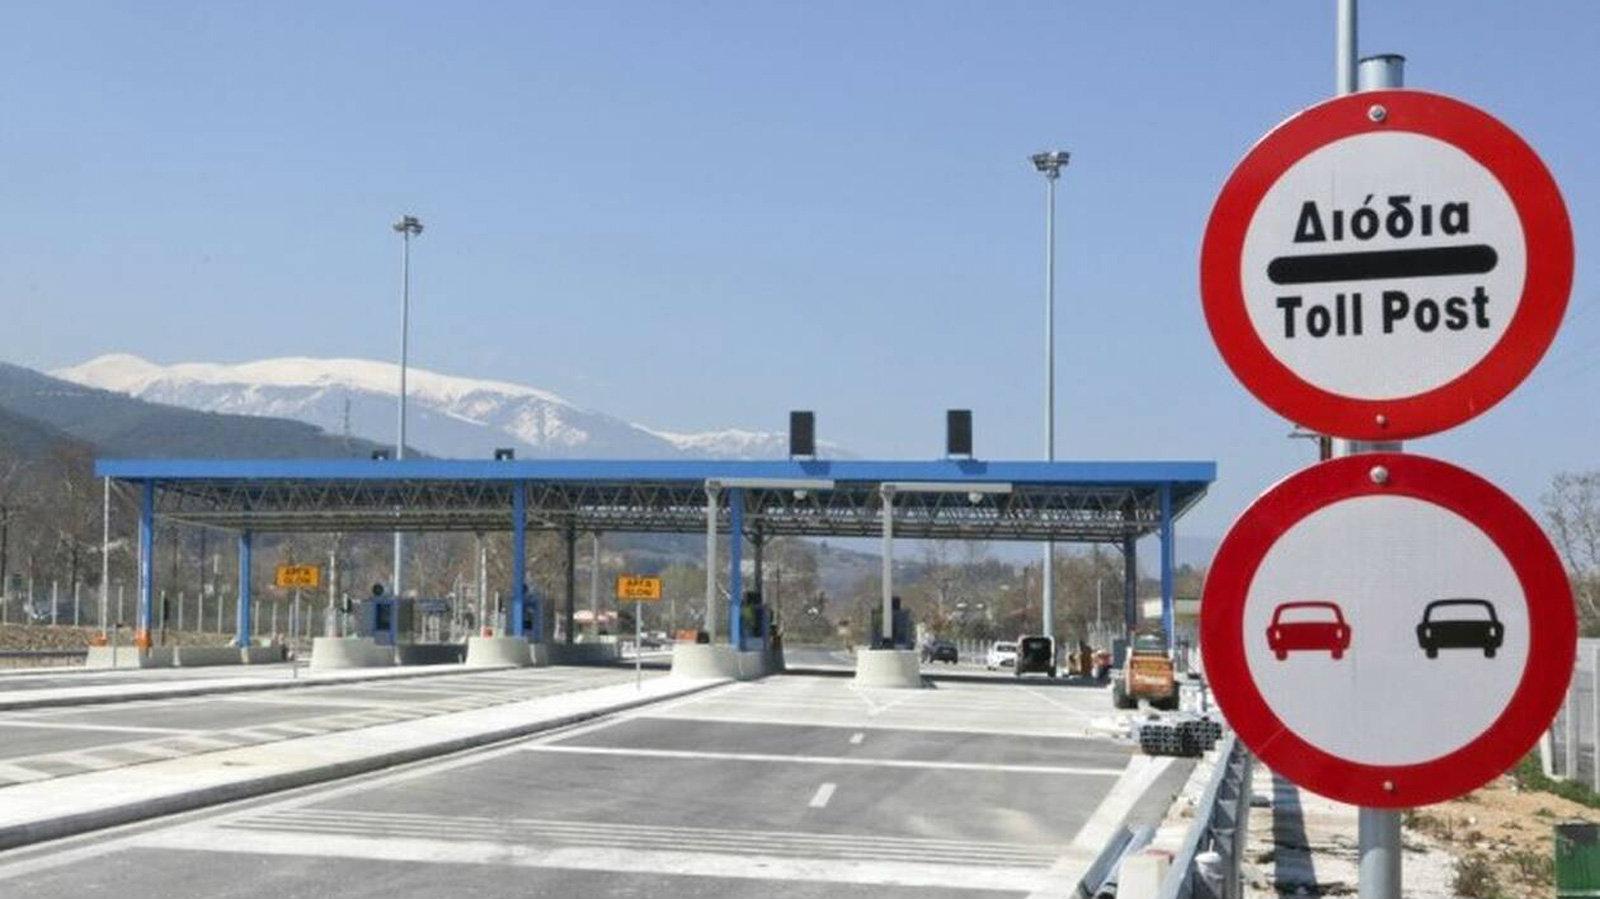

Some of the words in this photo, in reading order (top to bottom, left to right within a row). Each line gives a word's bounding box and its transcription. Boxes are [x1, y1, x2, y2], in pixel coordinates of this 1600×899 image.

[1293, 193, 1470, 243] Διόδια
[1276, 292, 1363, 338] Toll
[1382, 286, 1490, 334] Post
